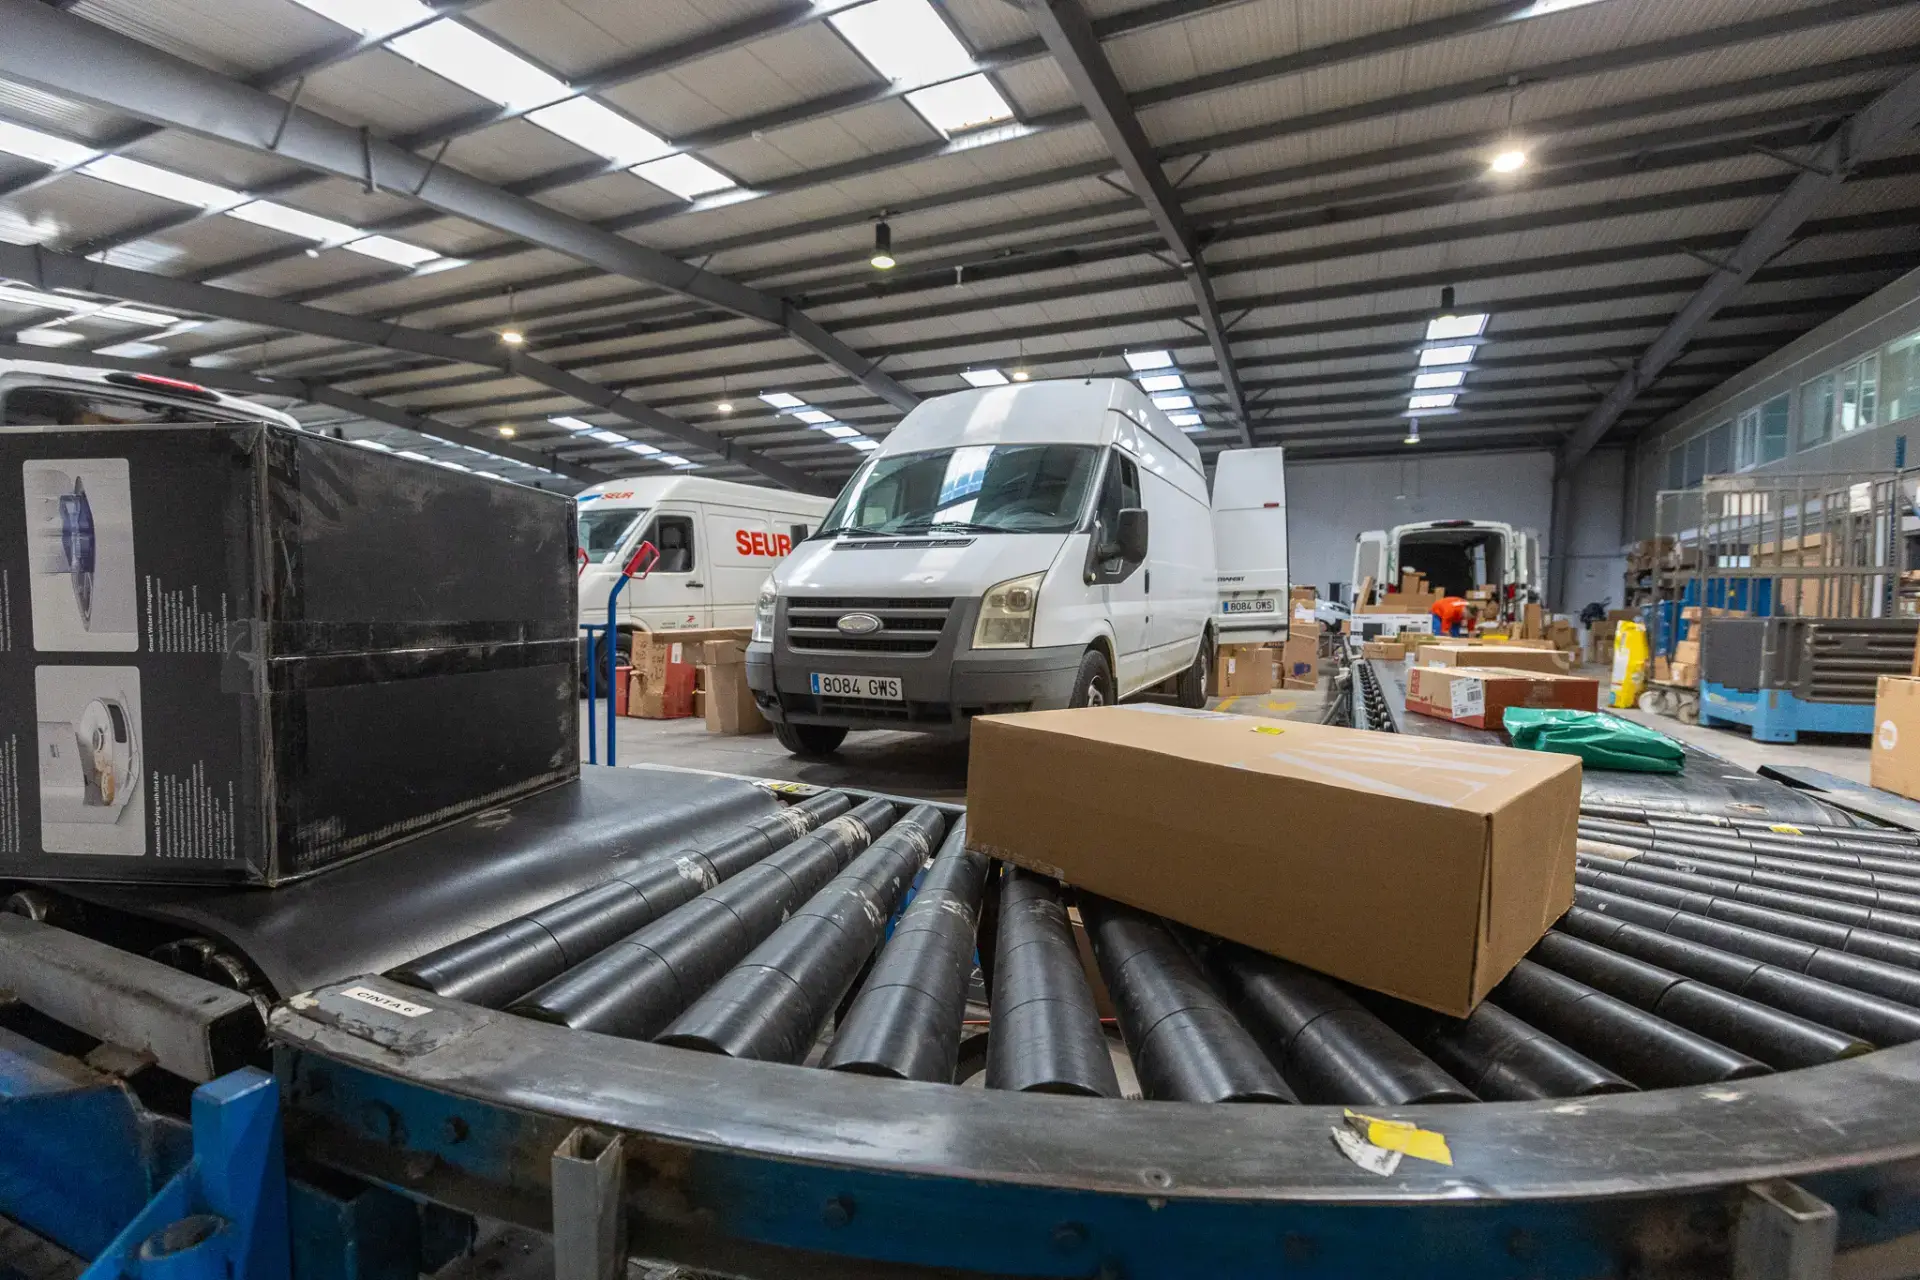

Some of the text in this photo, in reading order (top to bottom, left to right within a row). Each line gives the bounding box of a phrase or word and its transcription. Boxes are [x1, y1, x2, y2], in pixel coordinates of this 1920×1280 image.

[736, 530, 792, 557] SEUR
[1230, 601, 1272, 611] 8084 GWS
[823, 677, 898, 697] 8084 GWS
[357, 992, 401, 1009] CINTA
